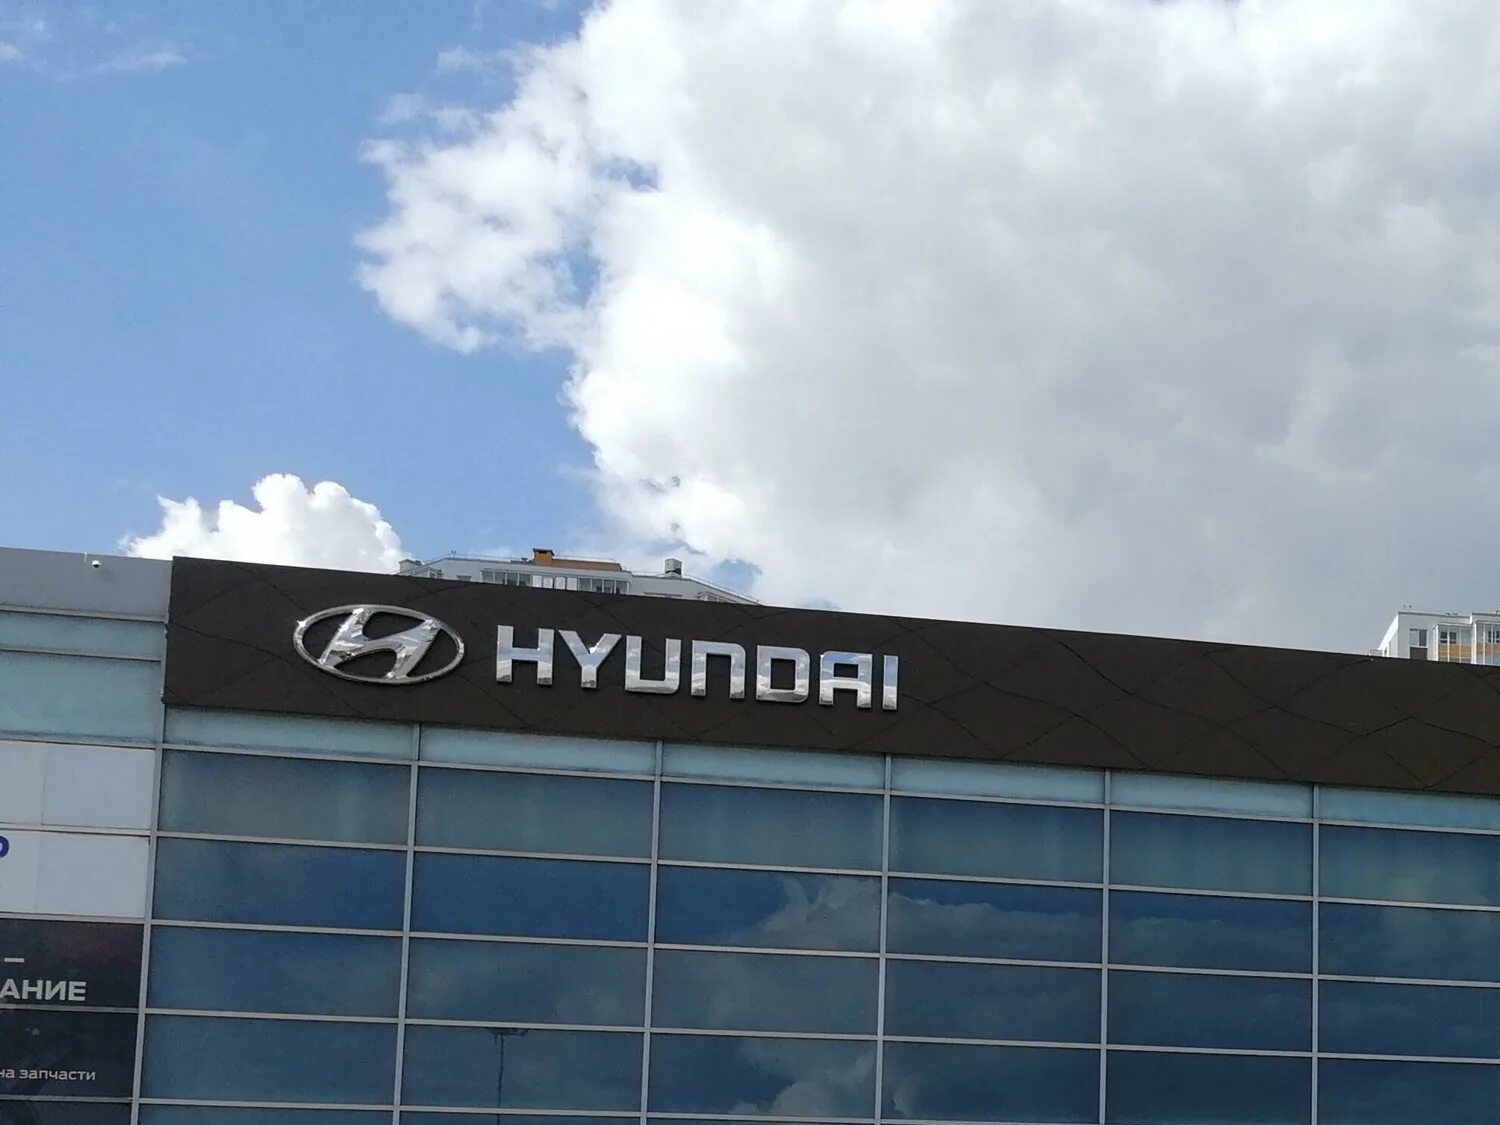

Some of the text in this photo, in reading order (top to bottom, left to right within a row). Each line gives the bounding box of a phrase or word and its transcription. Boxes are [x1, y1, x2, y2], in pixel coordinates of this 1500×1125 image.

[495, 624, 899, 711] HYUNDAI
[0, 978, 87, 1001] АНИЕ
[19, 1069, 96, 1080] запчасти
